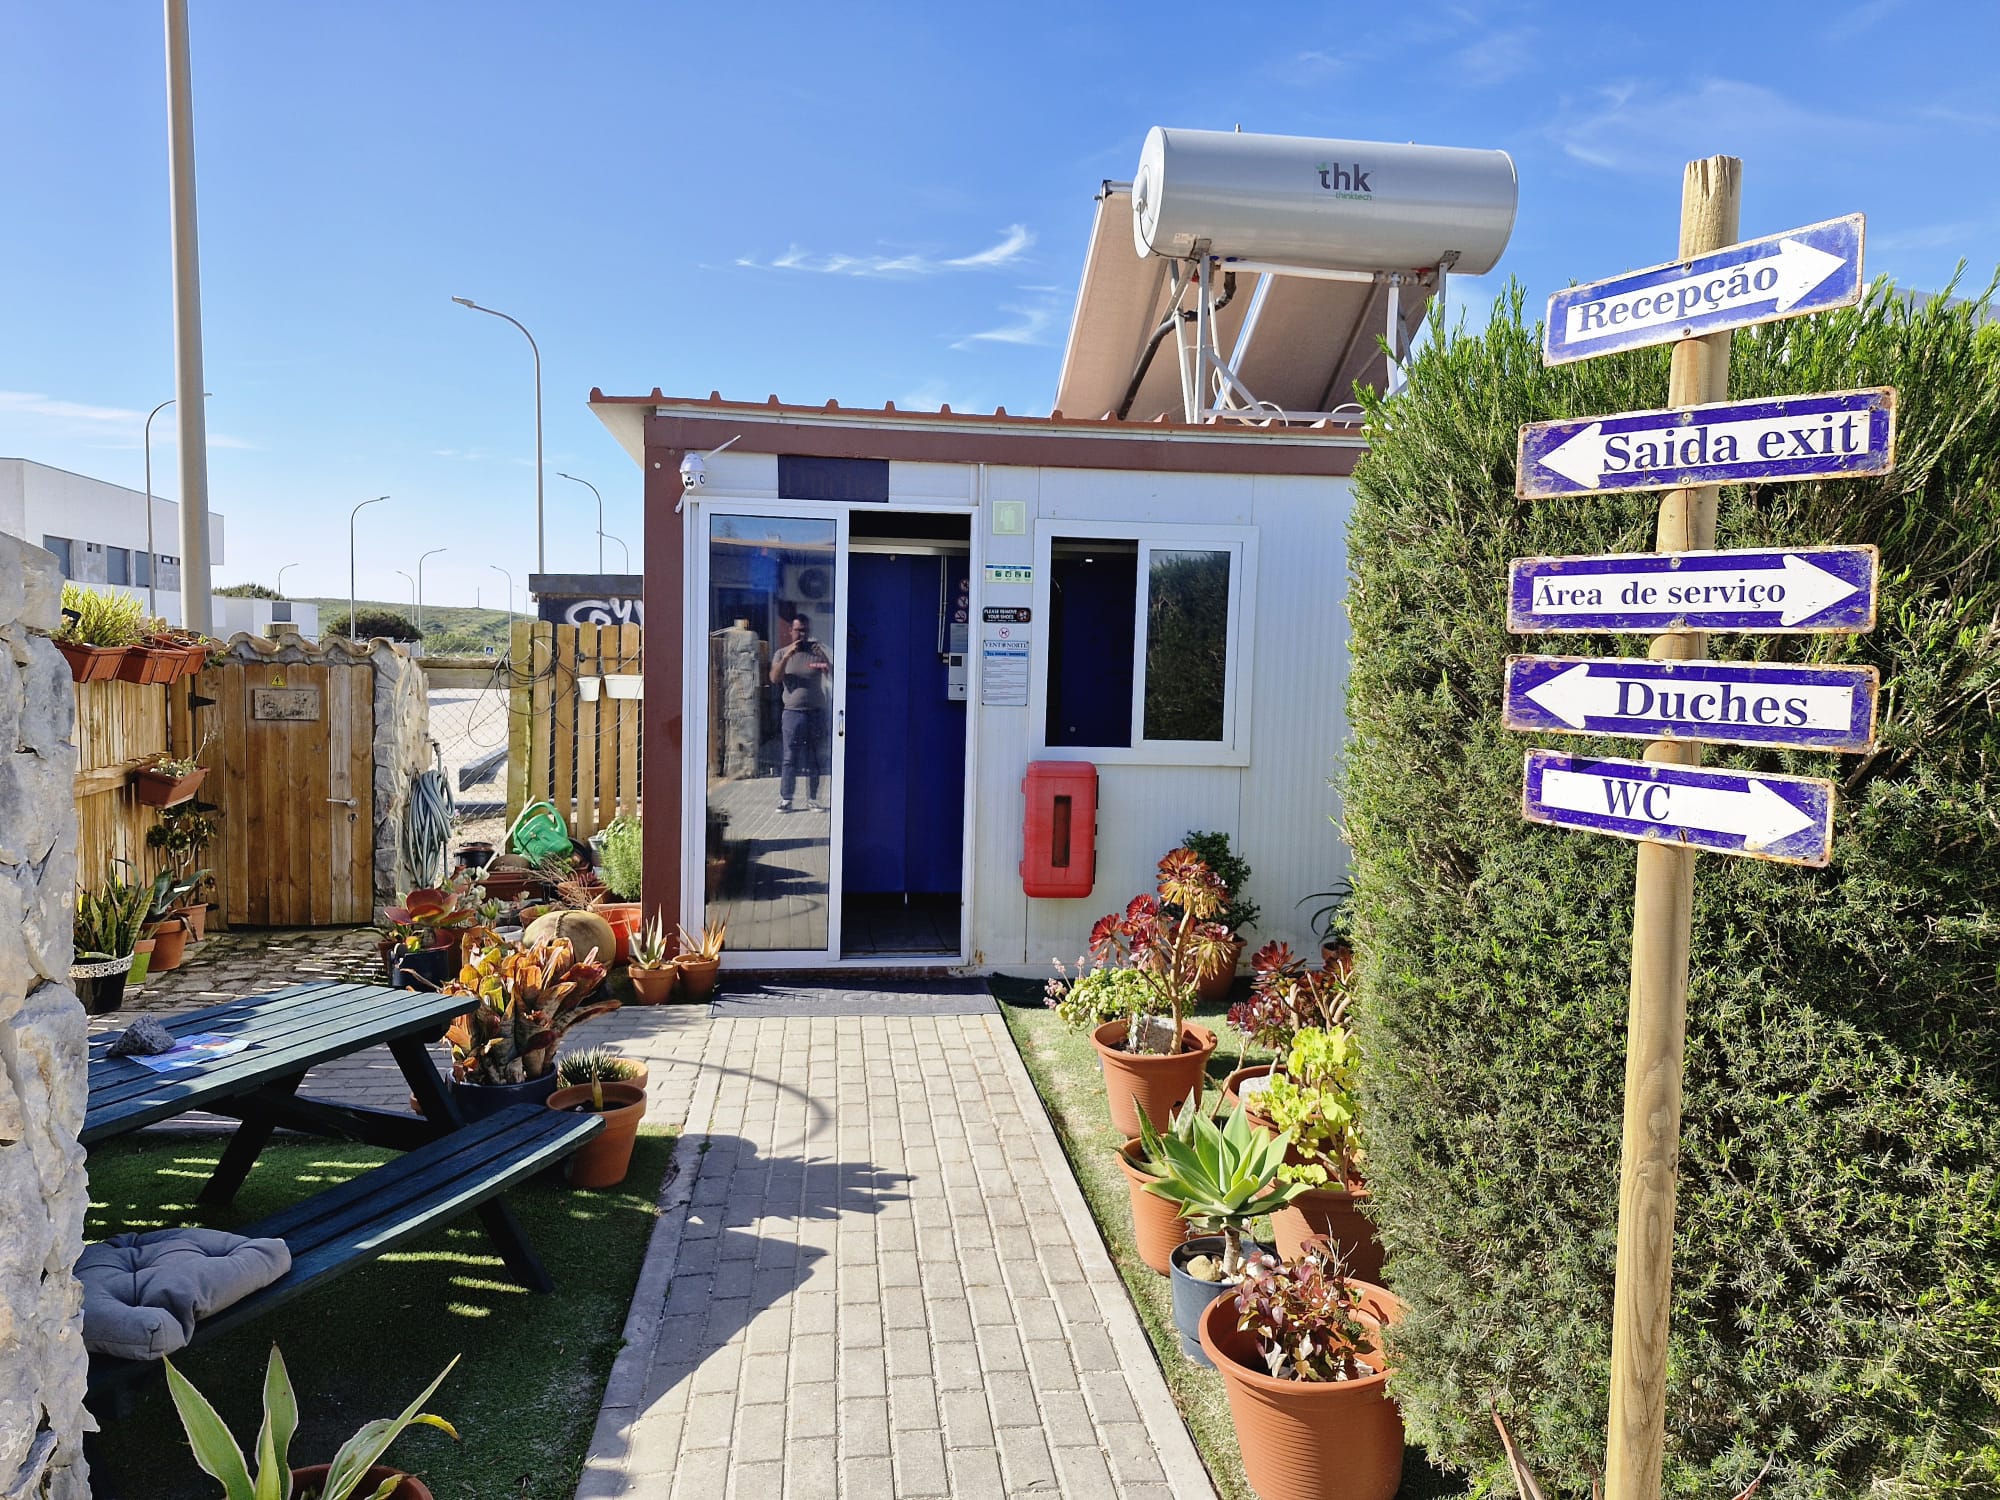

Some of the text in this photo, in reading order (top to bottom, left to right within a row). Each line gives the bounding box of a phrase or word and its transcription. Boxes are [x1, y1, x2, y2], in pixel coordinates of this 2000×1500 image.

[1318, 162, 1371, 192] thk
[1335, 192, 1372, 200] thinktech
[1576, 263, 1779, 333] Recepção
[1603, 413, 1860, 474] Saida exit
[1535, 577, 1786, 609] Área de serviço
[1614, 681, 1808, 727] Duches
[1601, 779, 1671, 821] WC
